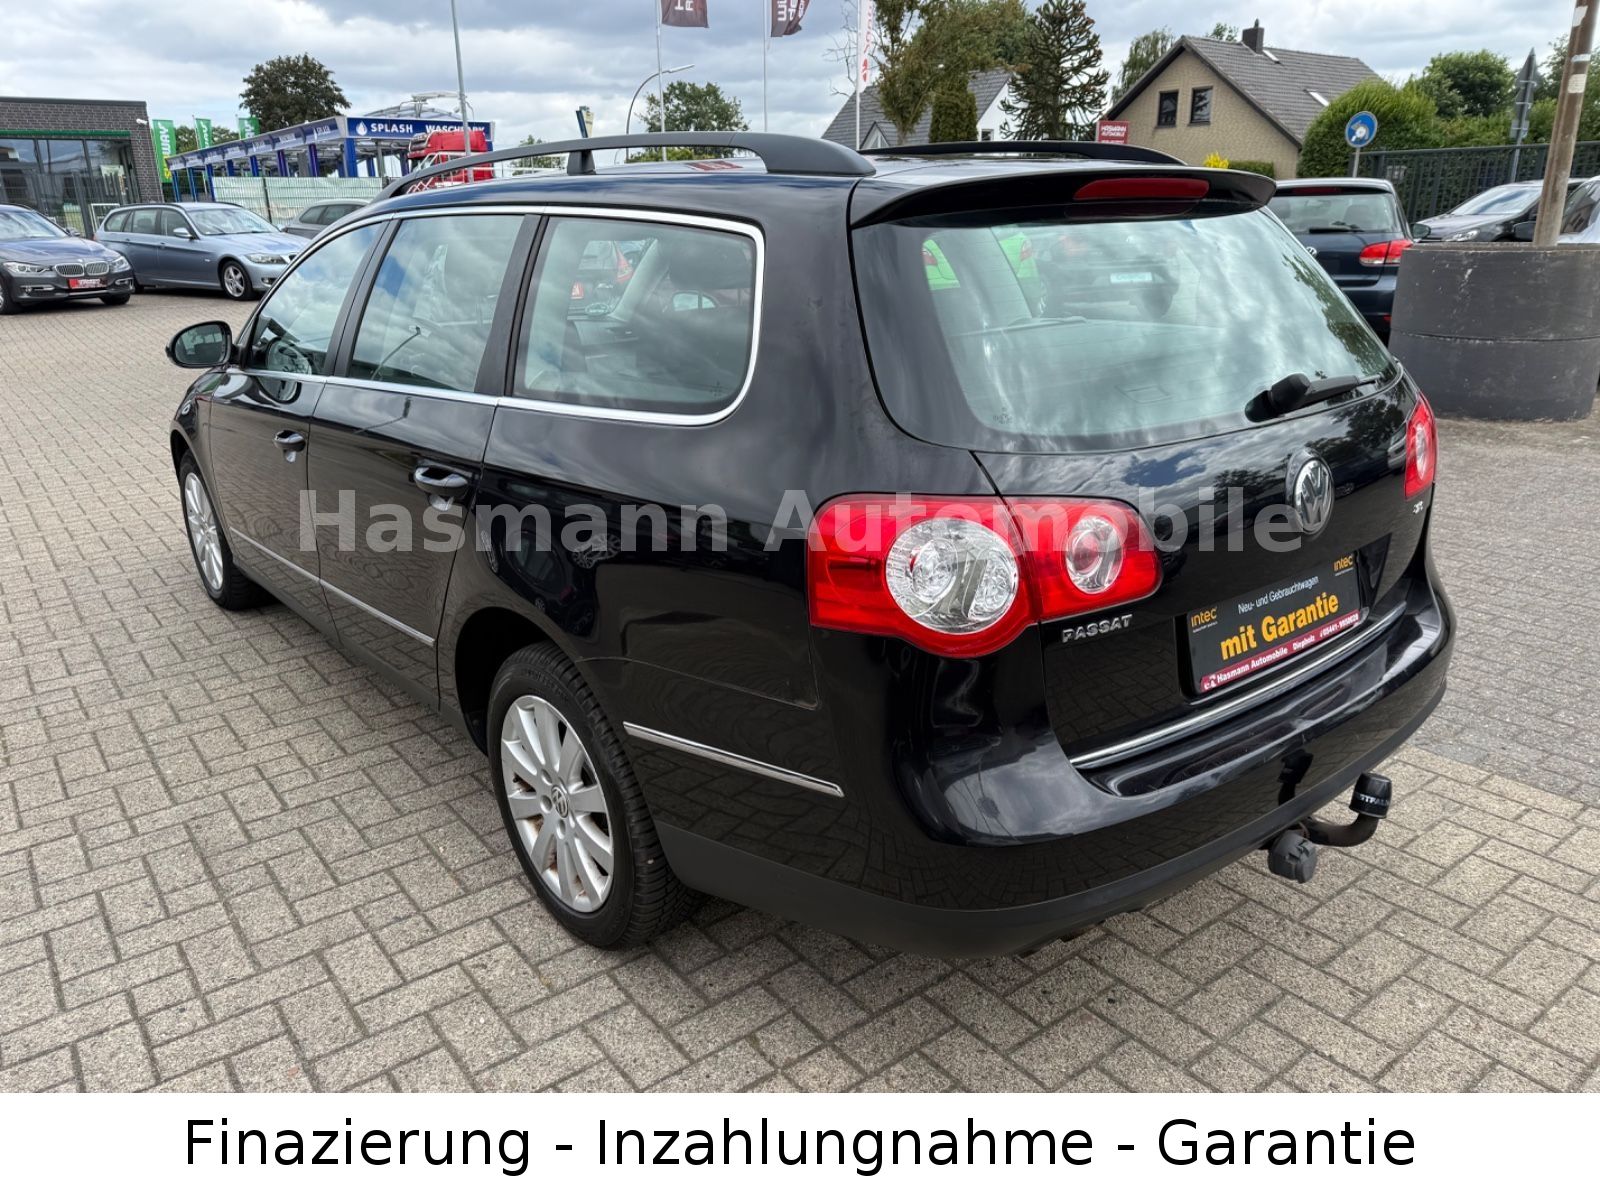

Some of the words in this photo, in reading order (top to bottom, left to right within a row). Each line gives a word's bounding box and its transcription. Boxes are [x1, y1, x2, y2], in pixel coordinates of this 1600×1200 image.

[371, 123, 413, 134] SPLASH
[157, 122, 172, 180] SWAY
[1256, 594, 1268, 608] und
[1269, 576, 1319, 602] Gebrauchtwagen
[1062, 613, 1133, 643] PASSAT
[1220, 624, 1257, 660] mit
[1262, 592, 1339, 642] Garantie
[1217, 663, 1250, 683] Hasmann
[1251, 647, 1288, 669] Automobile
